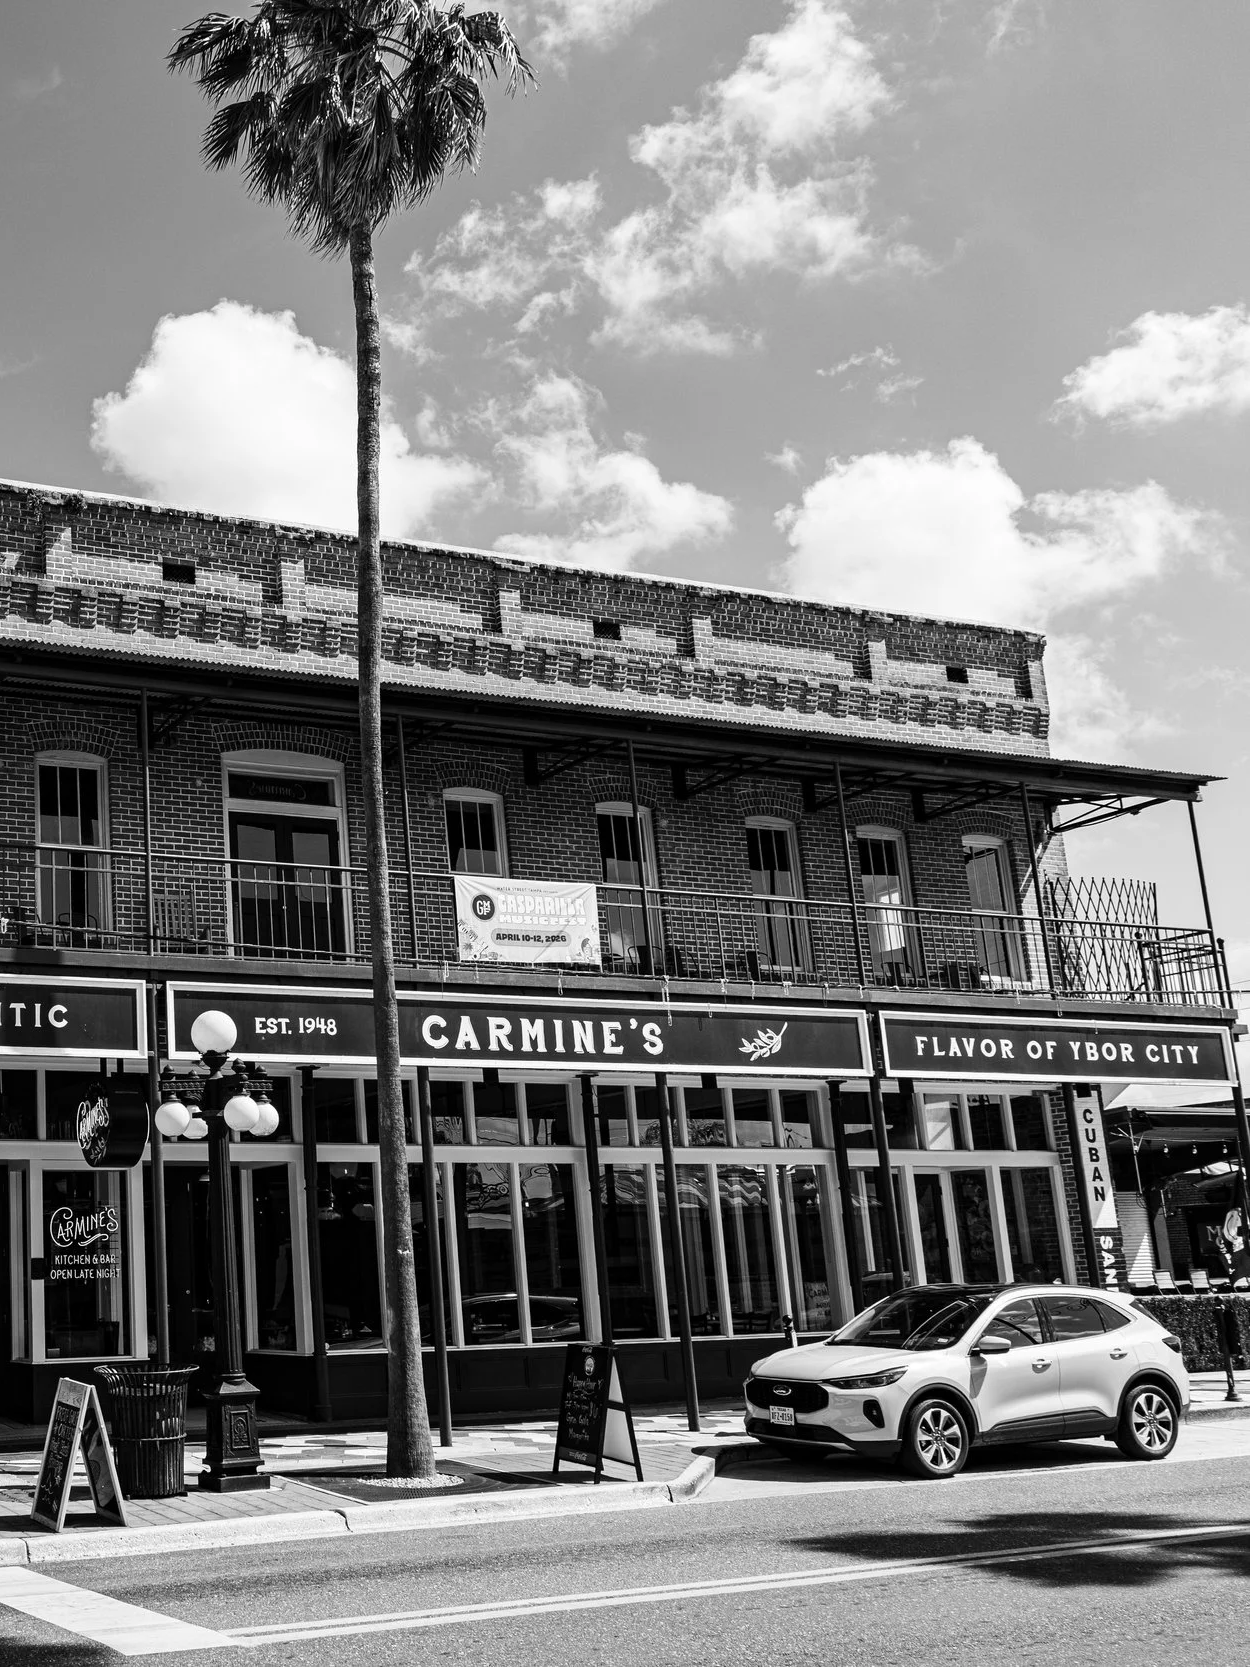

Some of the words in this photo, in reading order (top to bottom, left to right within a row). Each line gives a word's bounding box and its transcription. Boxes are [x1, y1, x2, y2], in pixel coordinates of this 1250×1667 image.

[497, 894, 586, 916] GASPARILLA
[495, 933, 520, 941] APRIL
[521, 934, 544, 943] 10-12,
[545, 934, 567, 943] 2026
[254, 1017, 292, 1035] EST.
[298, 1017, 338, 1036] 1948
[421, 1014, 665, 1056] CARMINE'S
[915, 1036, 1015, 1060] FLAVOR
[1026, 1040, 1057, 1060] OF
[1068, 1041, 1135, 1063] YBOR
[1145, 1044, 1199, 1064] CITY
[1082, 1108, 1106, 1202] CUBAN
[50, 1206, 119, 1247] CARMINE'S
[54, 1254, 90, 1264] KITCHEN
[92, 1254, 99, 1264] &
[100, 1254, 116, 1264] BAR
[1100, 1235, 1120, 1293] SAN
[50, 1269, 72, 1279] OPEN
[74, 1269, 94, 1279] LATE
[96, 1268, 121, 1278] NIGHT
